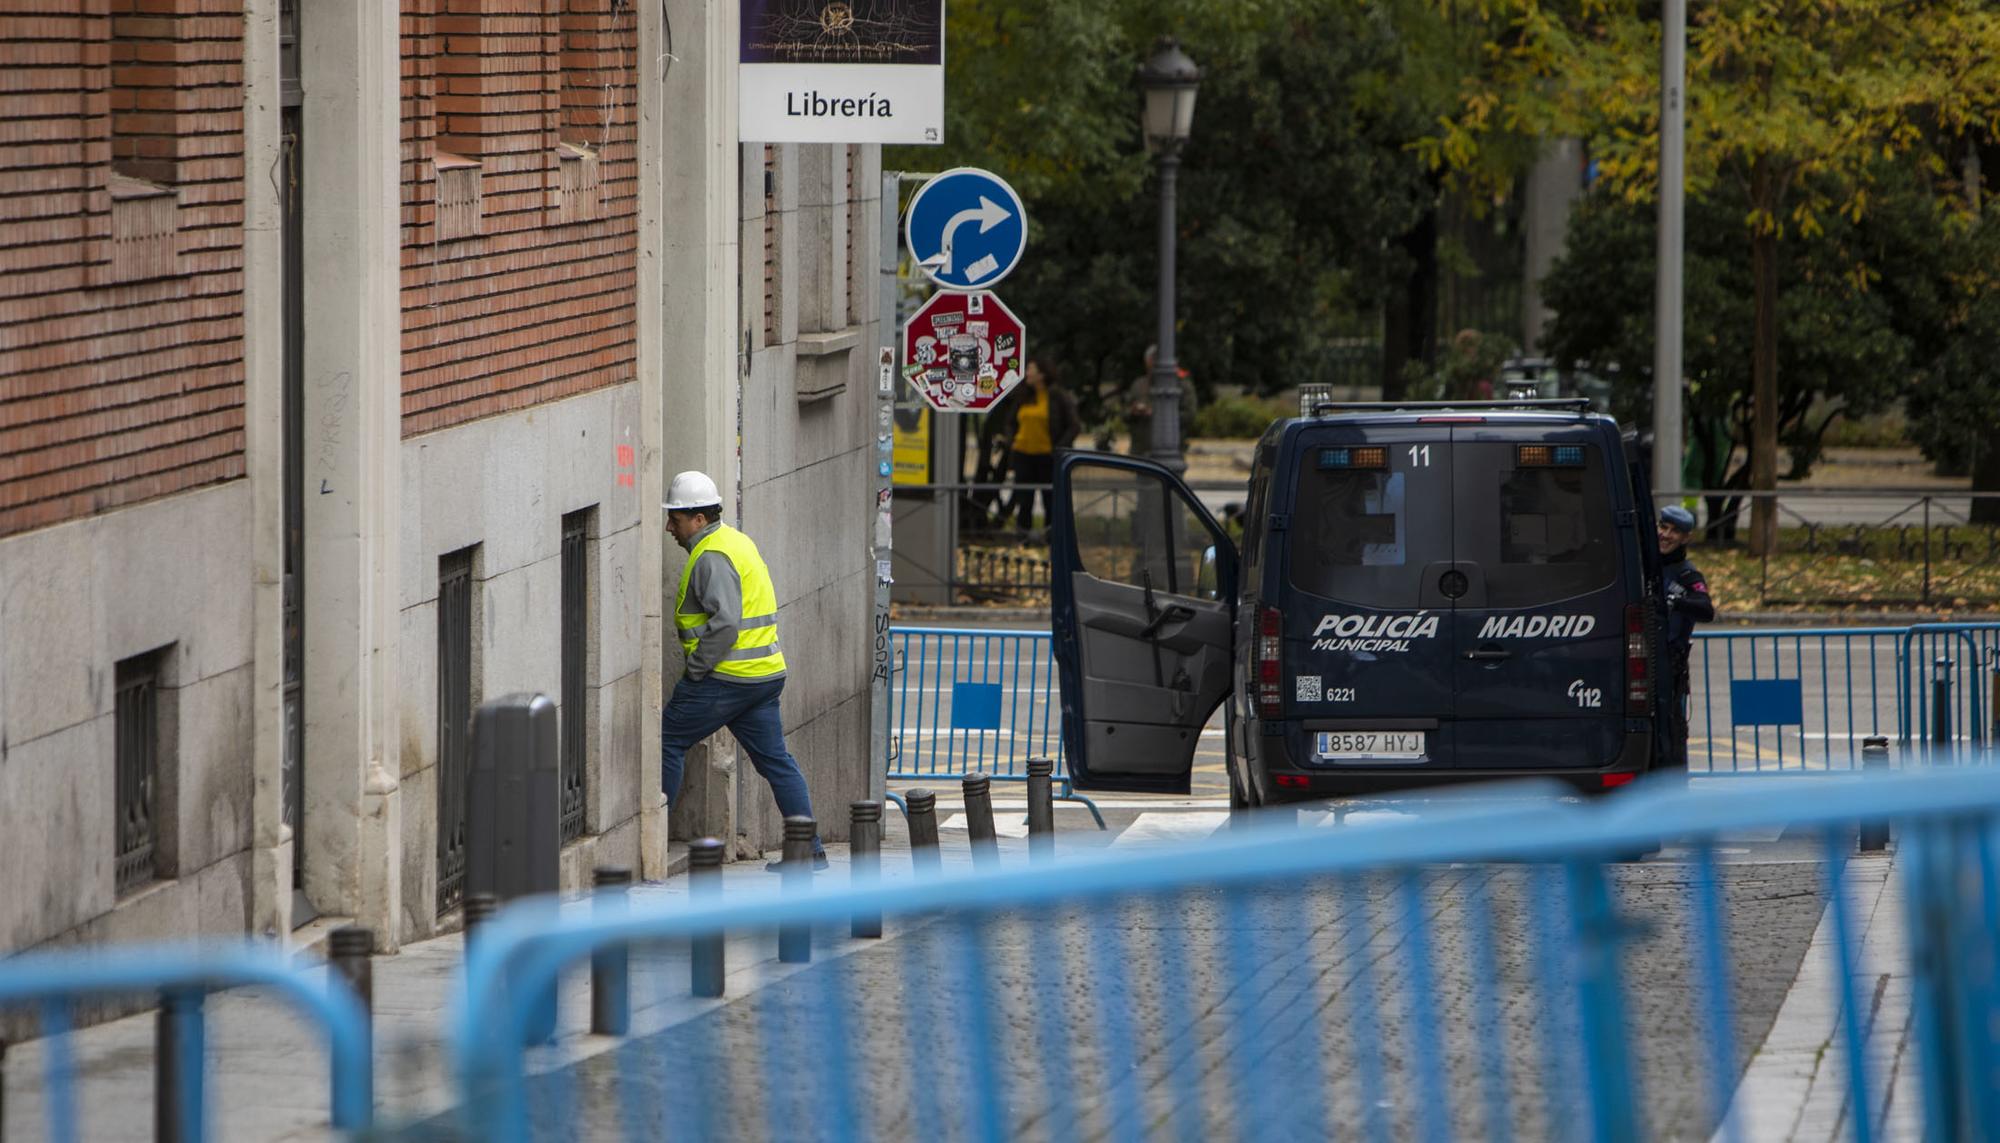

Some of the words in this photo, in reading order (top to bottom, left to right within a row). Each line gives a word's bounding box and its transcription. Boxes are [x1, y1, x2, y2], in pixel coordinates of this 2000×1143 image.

[787, 91, 893, 117] Librería
[1408, 444, 1430, 467] 11
[1312, 610, 1440, 639] POLICÍA
[1477, 615, 1596, 638] MADRID
[1311, 638, 1410, 652] MUNICIPAL
[1326, 688, 1355, 702] 6221
[1576, 688, 1602, 707] 112
[1331, 734, 1377, 752] 8587
[1384, 734, 1420, 752] HYJ
